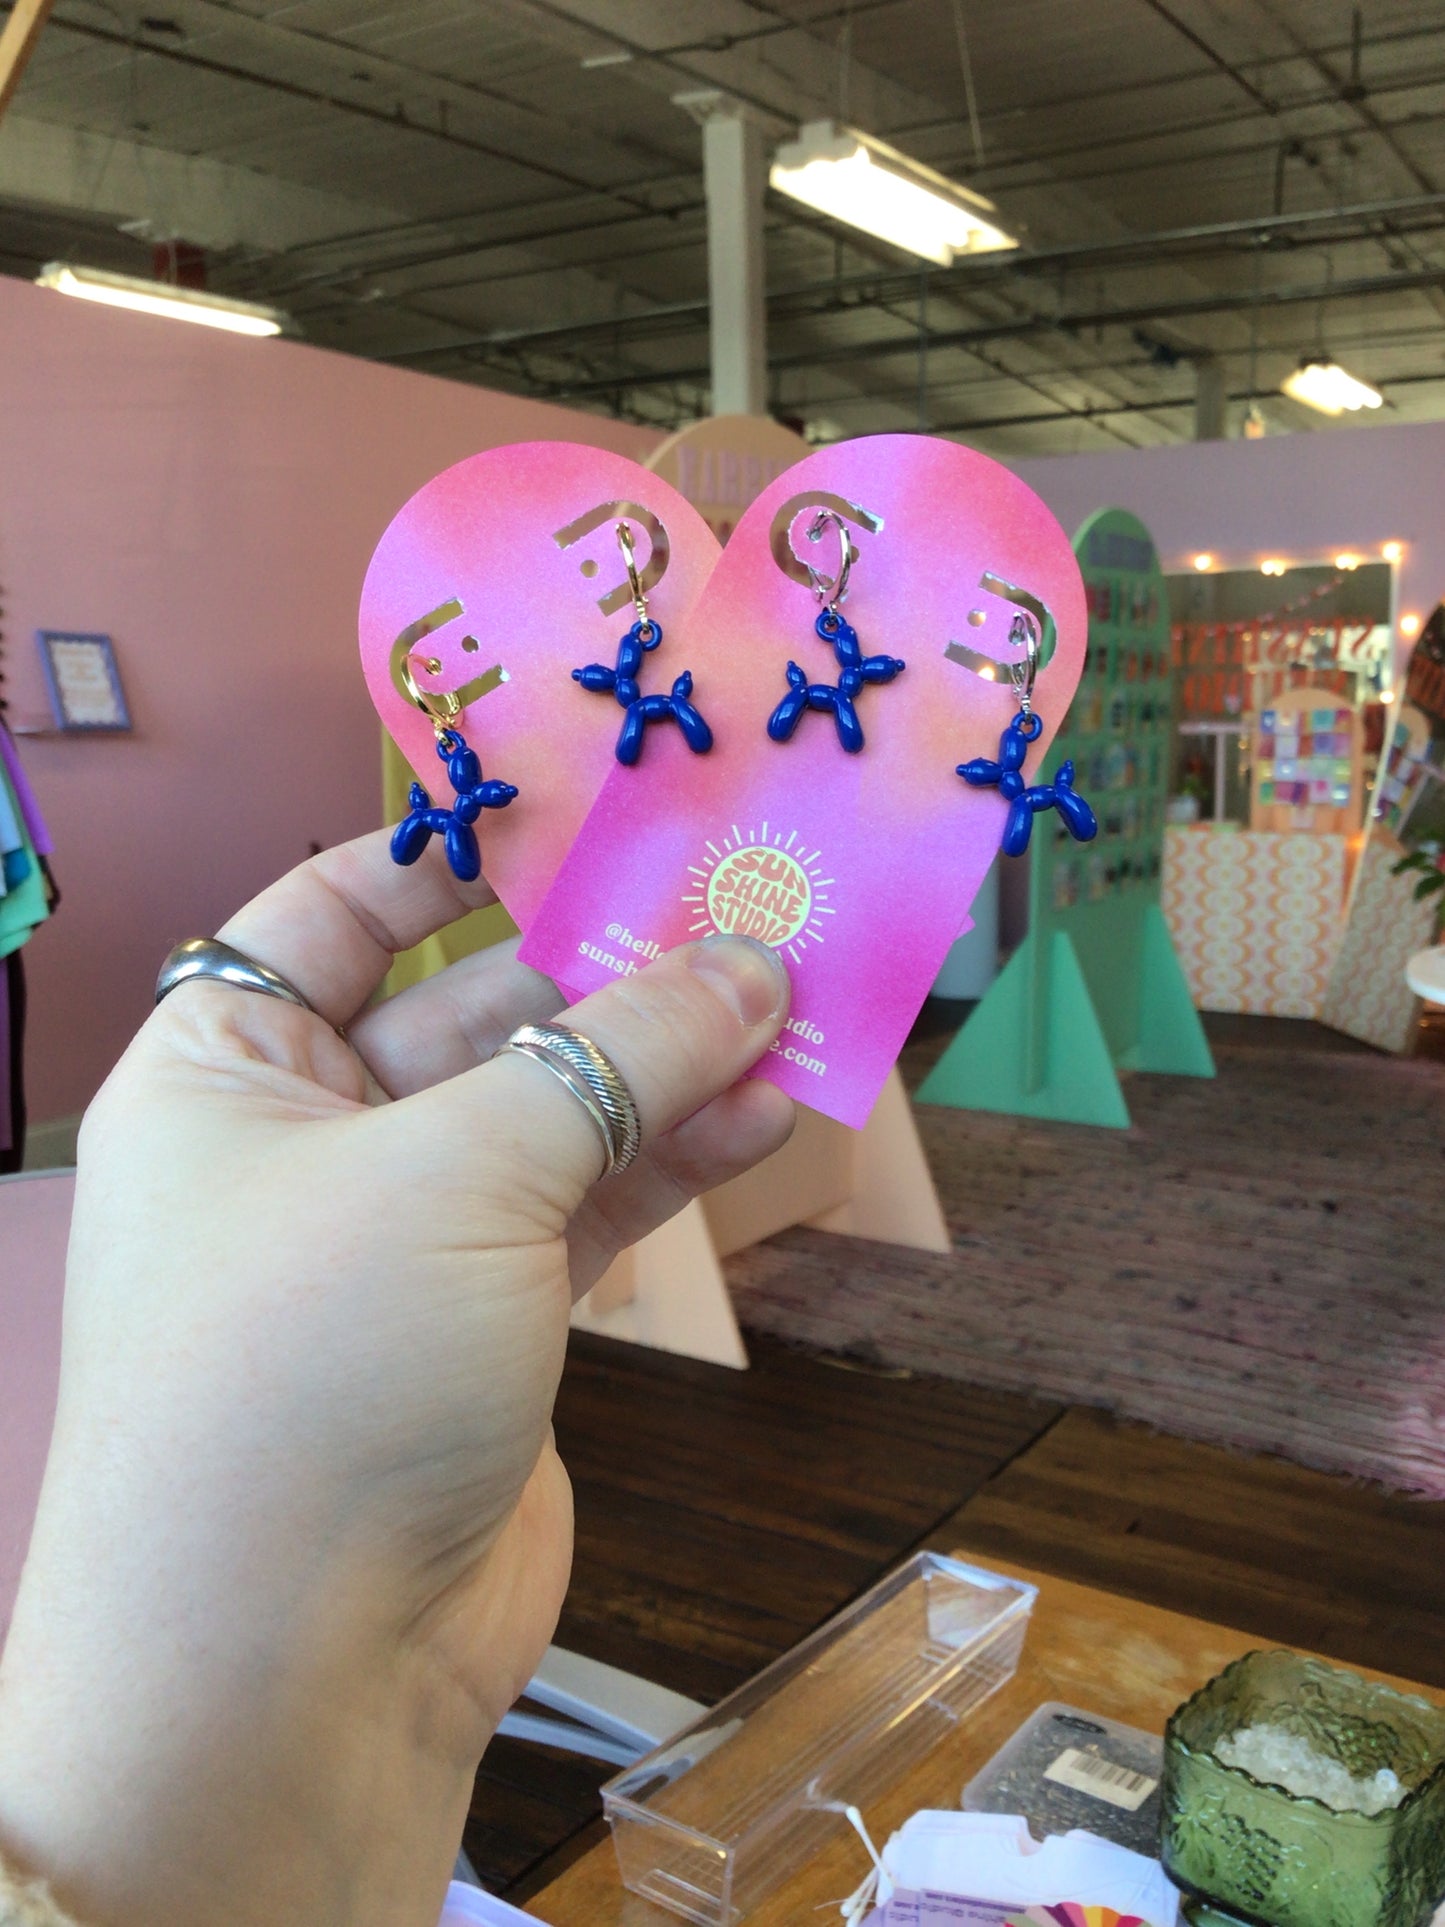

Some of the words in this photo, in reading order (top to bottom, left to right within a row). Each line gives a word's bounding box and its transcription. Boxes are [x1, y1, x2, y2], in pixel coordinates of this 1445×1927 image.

[714, 868, 803, 924] SHINE
[731, 850, 807, 900] SUN
[712, 894, 791, 944] STUDIO
